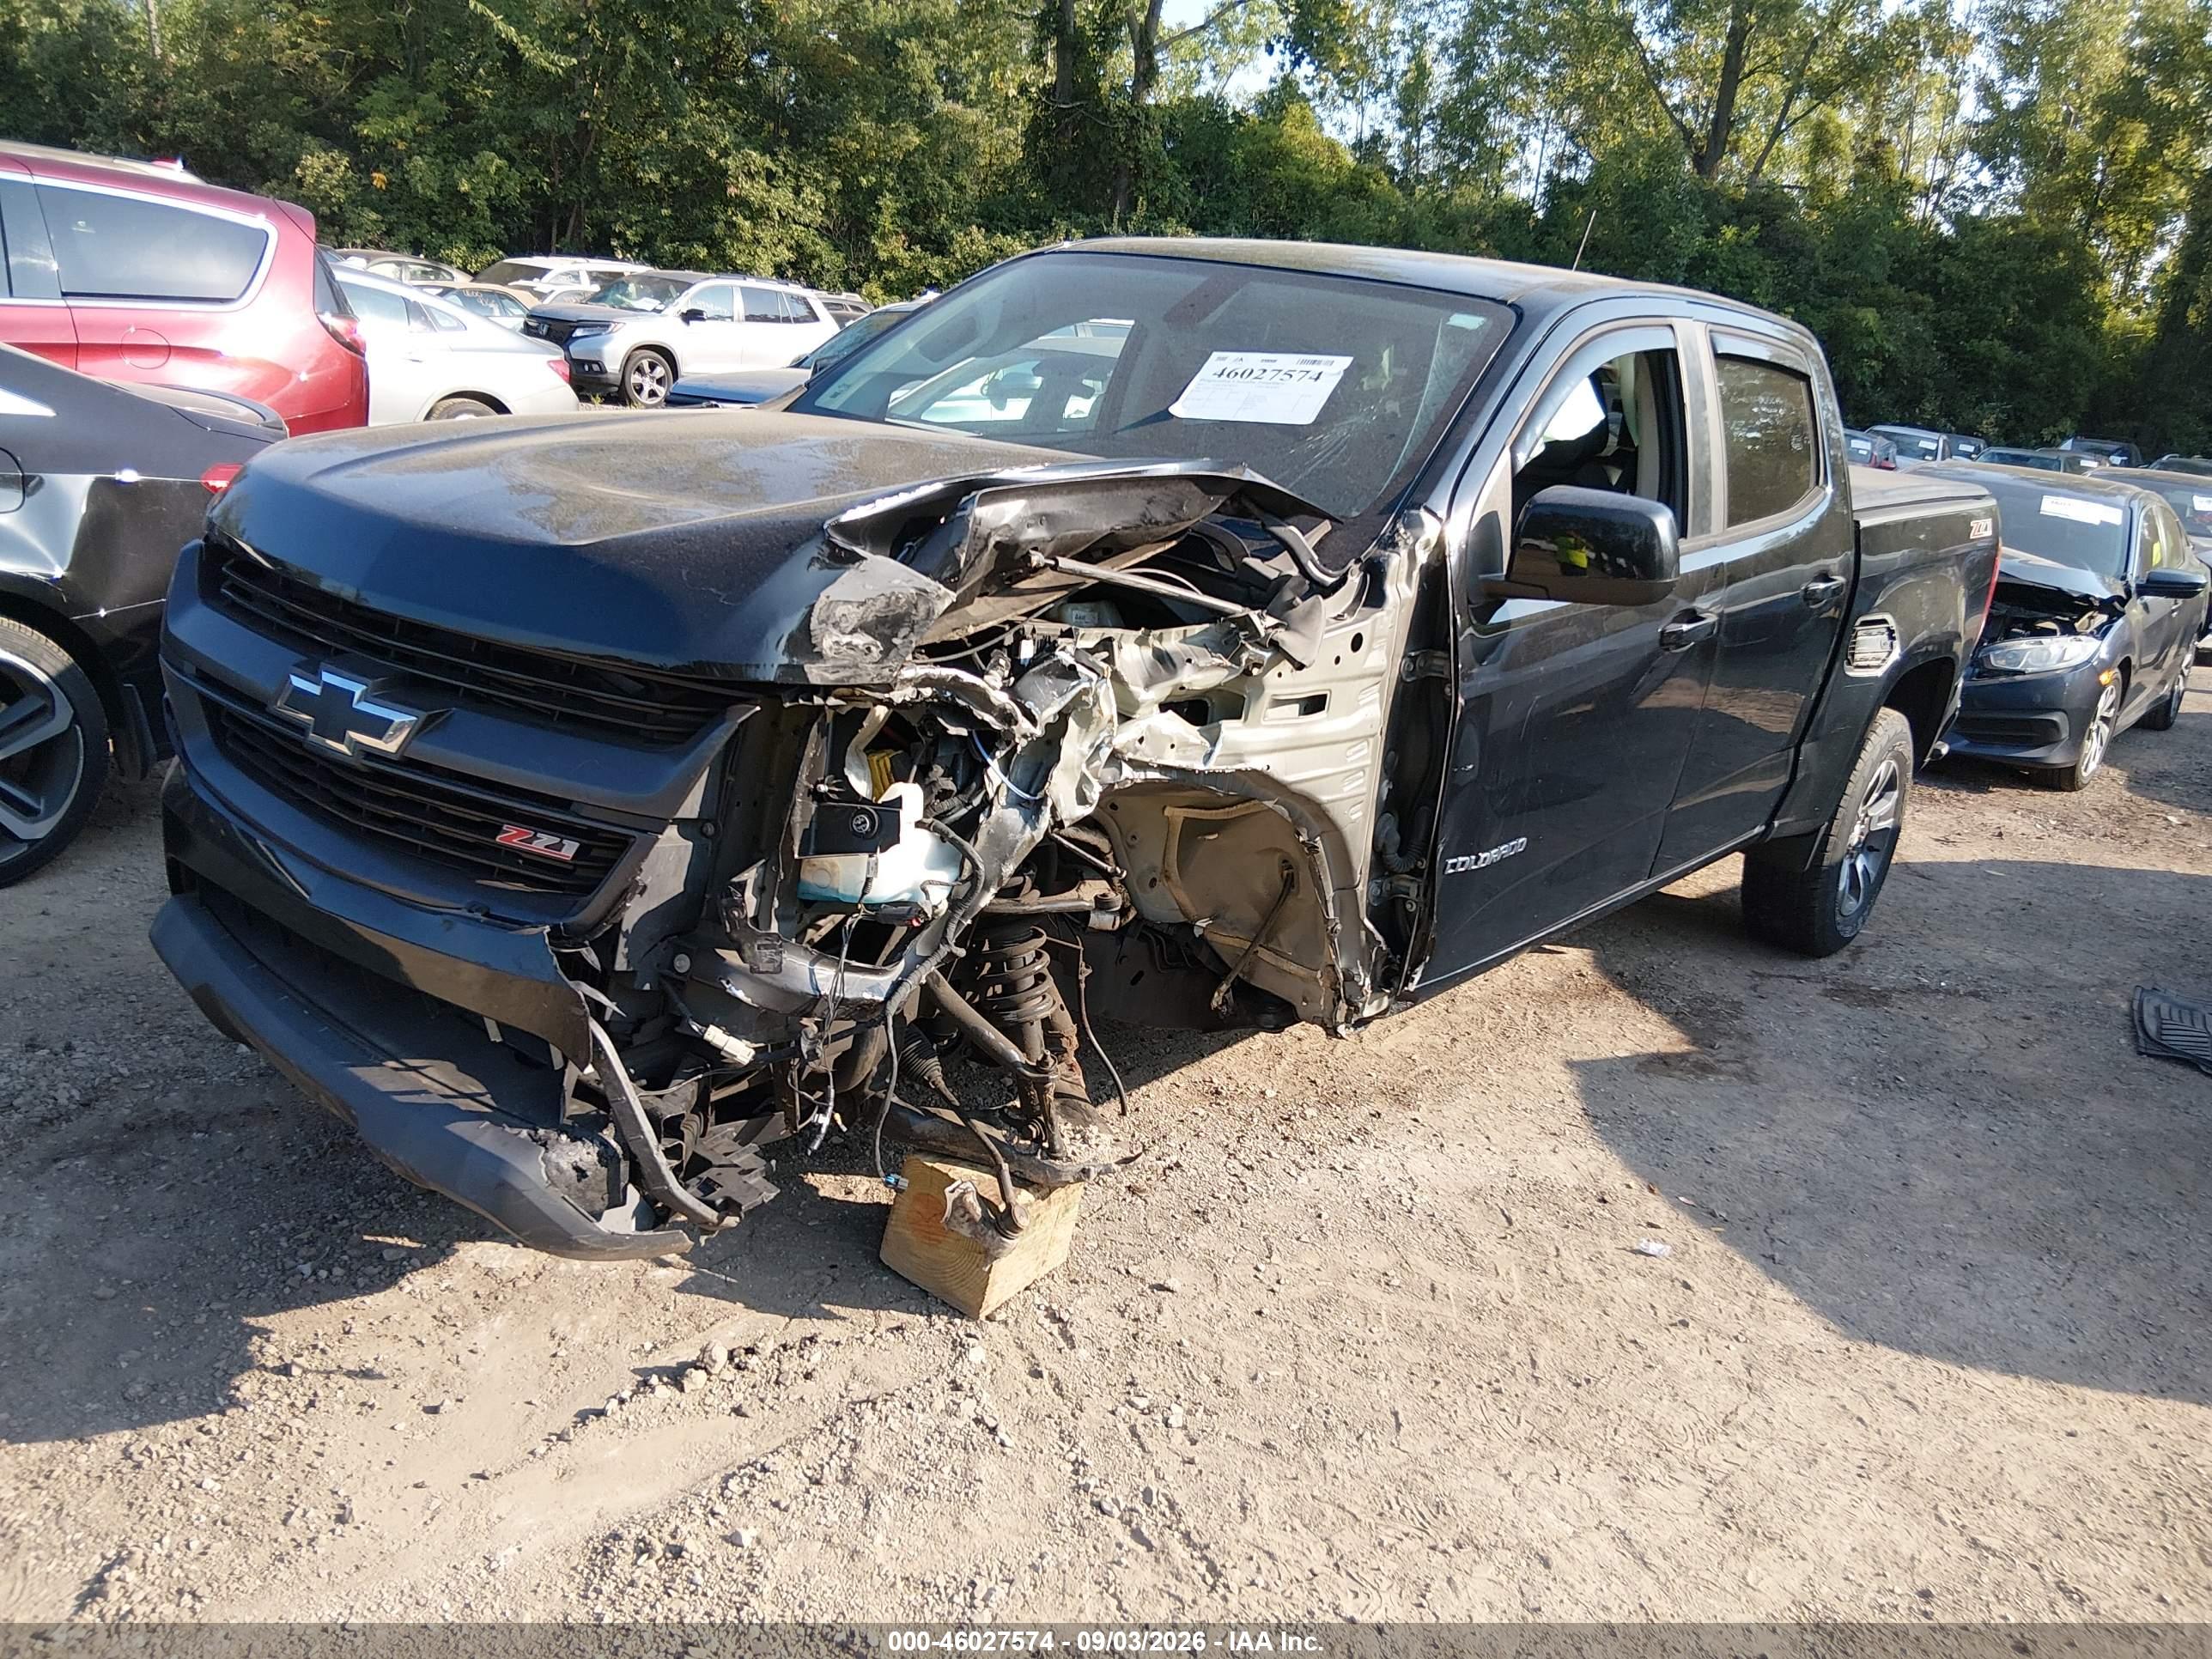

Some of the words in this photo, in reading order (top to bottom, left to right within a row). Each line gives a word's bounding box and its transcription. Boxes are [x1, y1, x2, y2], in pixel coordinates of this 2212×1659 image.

[1212, 367, 1323, 382] 46027574
[495, 824, 580, 860] Z71
[1443, 836, 1528, 875] COLORADO
